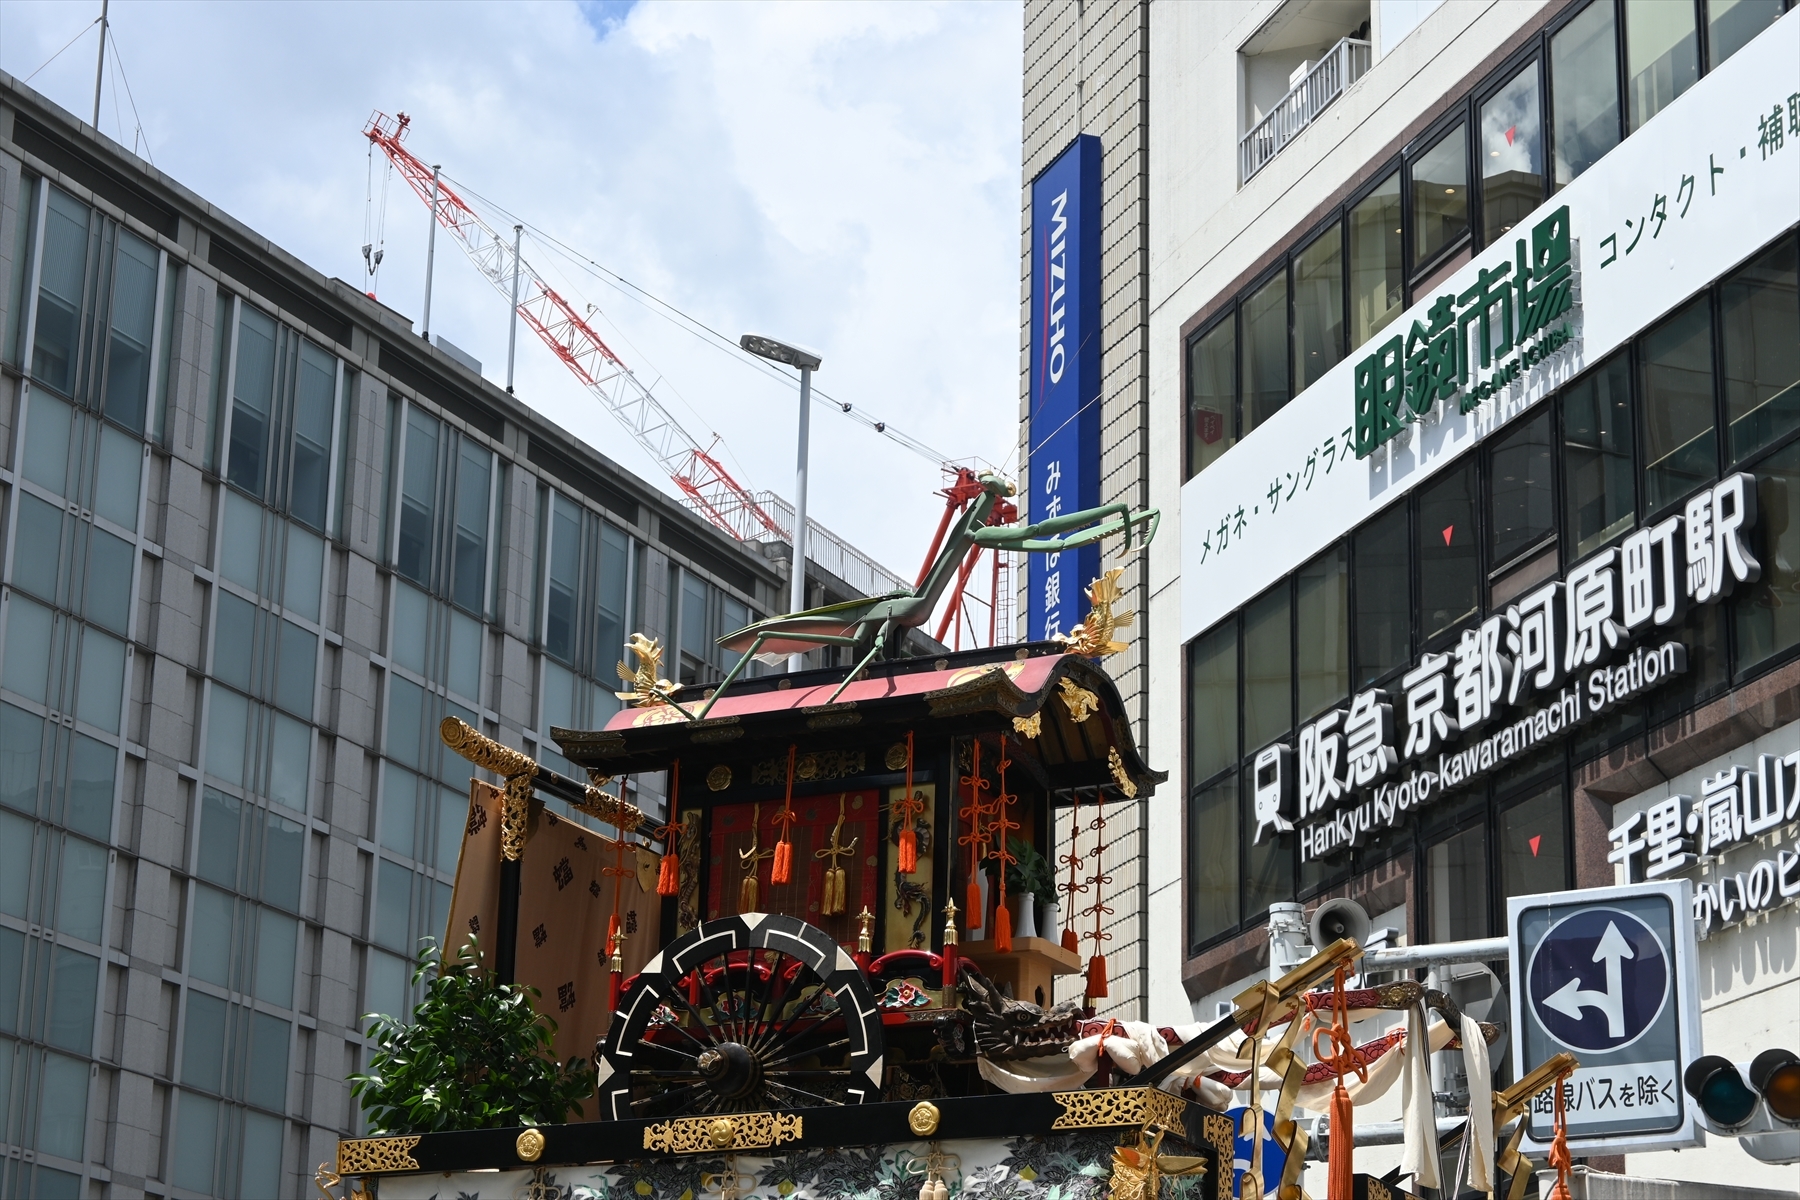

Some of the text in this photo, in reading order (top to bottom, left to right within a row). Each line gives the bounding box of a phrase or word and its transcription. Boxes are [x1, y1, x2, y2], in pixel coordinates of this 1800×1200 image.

[1050, 188, 1067, 384] MIZUHO
[1355, 204, 1574, 460] 眼鏡市場
[1460, 322, 1575, 416] MEGANE ICHIBA
[1200, 426, 1357, 565] メガネ・サングラス
[1300, 471, 1758, 819] 阪急 京都河原町駅
[1300, 641, 1676, 864] Hankyu Kyoto-kawaramachi Station
[1534, 1075, 1675, 1114] 路線バスを除く
